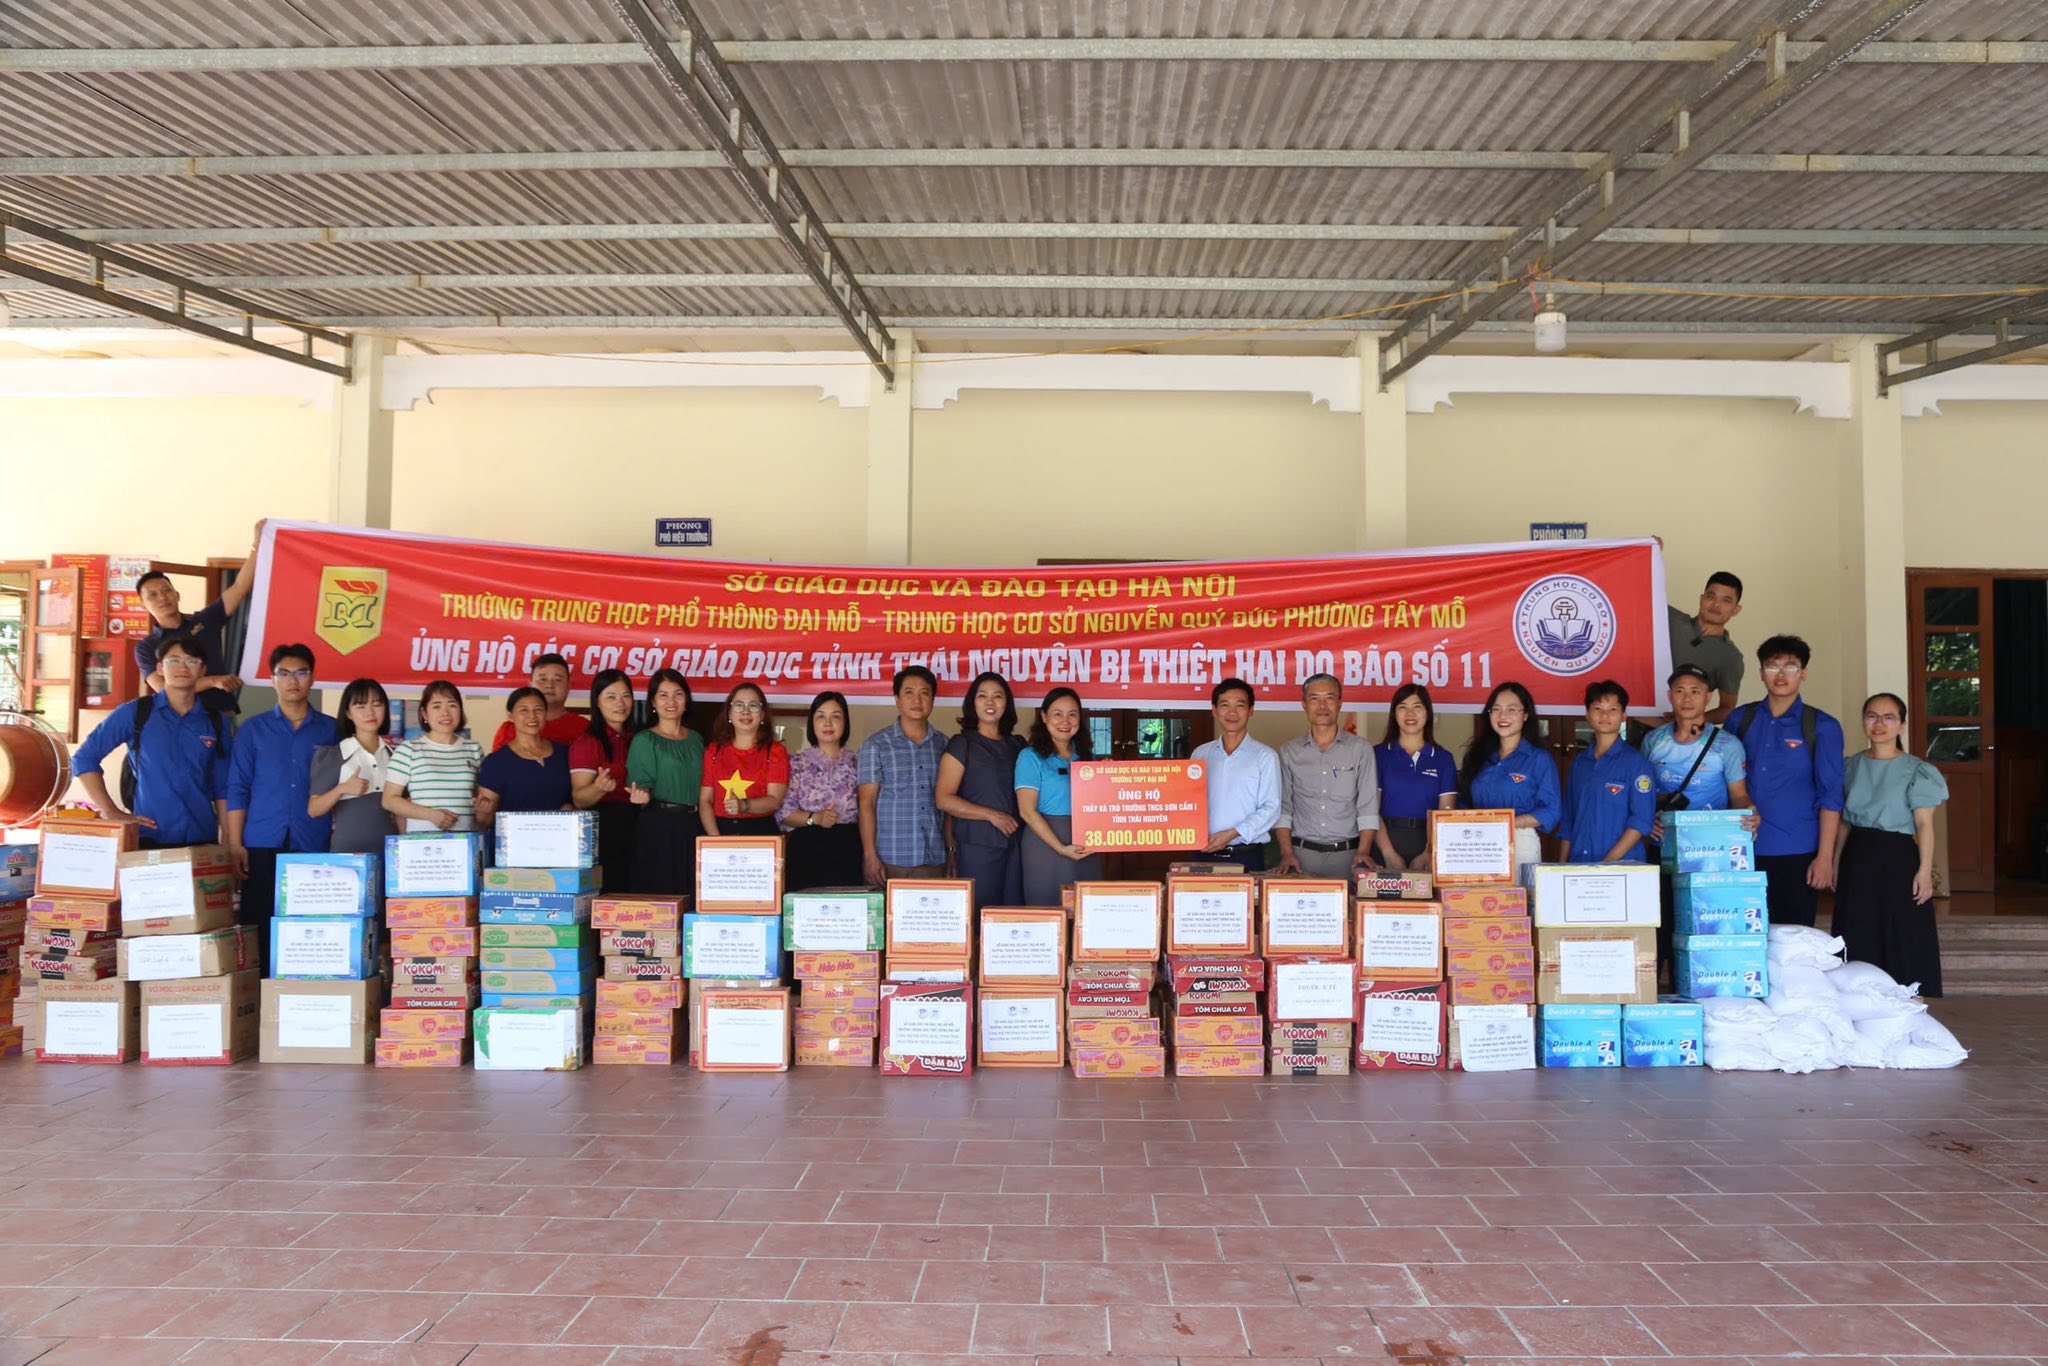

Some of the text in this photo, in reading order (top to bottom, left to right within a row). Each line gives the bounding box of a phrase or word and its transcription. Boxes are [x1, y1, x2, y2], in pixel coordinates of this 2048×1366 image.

[724, 571, 1236, 602] SỞ GIÁO DỤC VÀ ĐÀO TẠO HÀ NỘI
[1522, 585, 1550, 617] TRUNG
[440, 592, 524, 621] TRƯỜNG
[530, 598, 601, 624] TRUNG
[606, 601, 651, 629] HỌC
[655, 596, 701, 628] PHỔ
[705, 602, 779, 630] THÔNG
[783, 607, 820, 636] ĐẠI
[826, 601, 861, 633] MỖ
[883, 610, 956, 634] TRUNG
[962, 611, 1007, 638] HỌC
[1013, 610, 1043, 635] CƠ
[1048, 605, 1079, 635] SỞ
[1083, 604, 1174, 634] NGUYỄN
[1181, 607, 1226, 628] QUÝ
[1232, 607, 1278, 628] ĐỨC
[1284, 601, 1374, 629] PHƯỜNG
[1381, 600, 1425, 628] TÂY
[1430, 596, 1466, 629] MỖ
[410, 628, 470, 673] ỦNG
[475, 634, 517, 680] HỘ
[581, 645, 623, 677] CƠ
[626, 637, 668, 677] SỞ
[671, 642, 739, 679] GIÁO
[743, 650, 803, 685] DỤC
[810, 643, 883, 680] TỈNH
[968, 642, 1092, 683] NGUYÊN
[1100, 649, 1131, 690] BỊ
[1139, 642, 1226, 692] THIỆT
[1235, 649, 1286, 692] HẠI
[1295, 650, 1335, 686] DO
[1343, 644, 1403, 687] BÃO
[1411, 638, 1449, 687] SỐ
[1461, 651, 1492, 688] 11
[1118, 788, 1160, 801] ỦNG HỘ
[1085, 828, 1196, 847] 38.000.000 VNĐ
[1368, 880, 1412, 889] KOKOMI
[612, 938, 656, 949] KOKOMI
[31, 960, 73, 971] KOKOMI
[404, 965, 446, 974] KOKOMI
[626, 964, 671, 975] KOKOMI
[1209, 980, 1248, 990] KOKOMI
[1189, 992, 1221, 1000] KOKOMI
[1283, 1029, 1328, 1039] KOKOMI
[1283, 1055, 1327, 1066] KOKOMI
